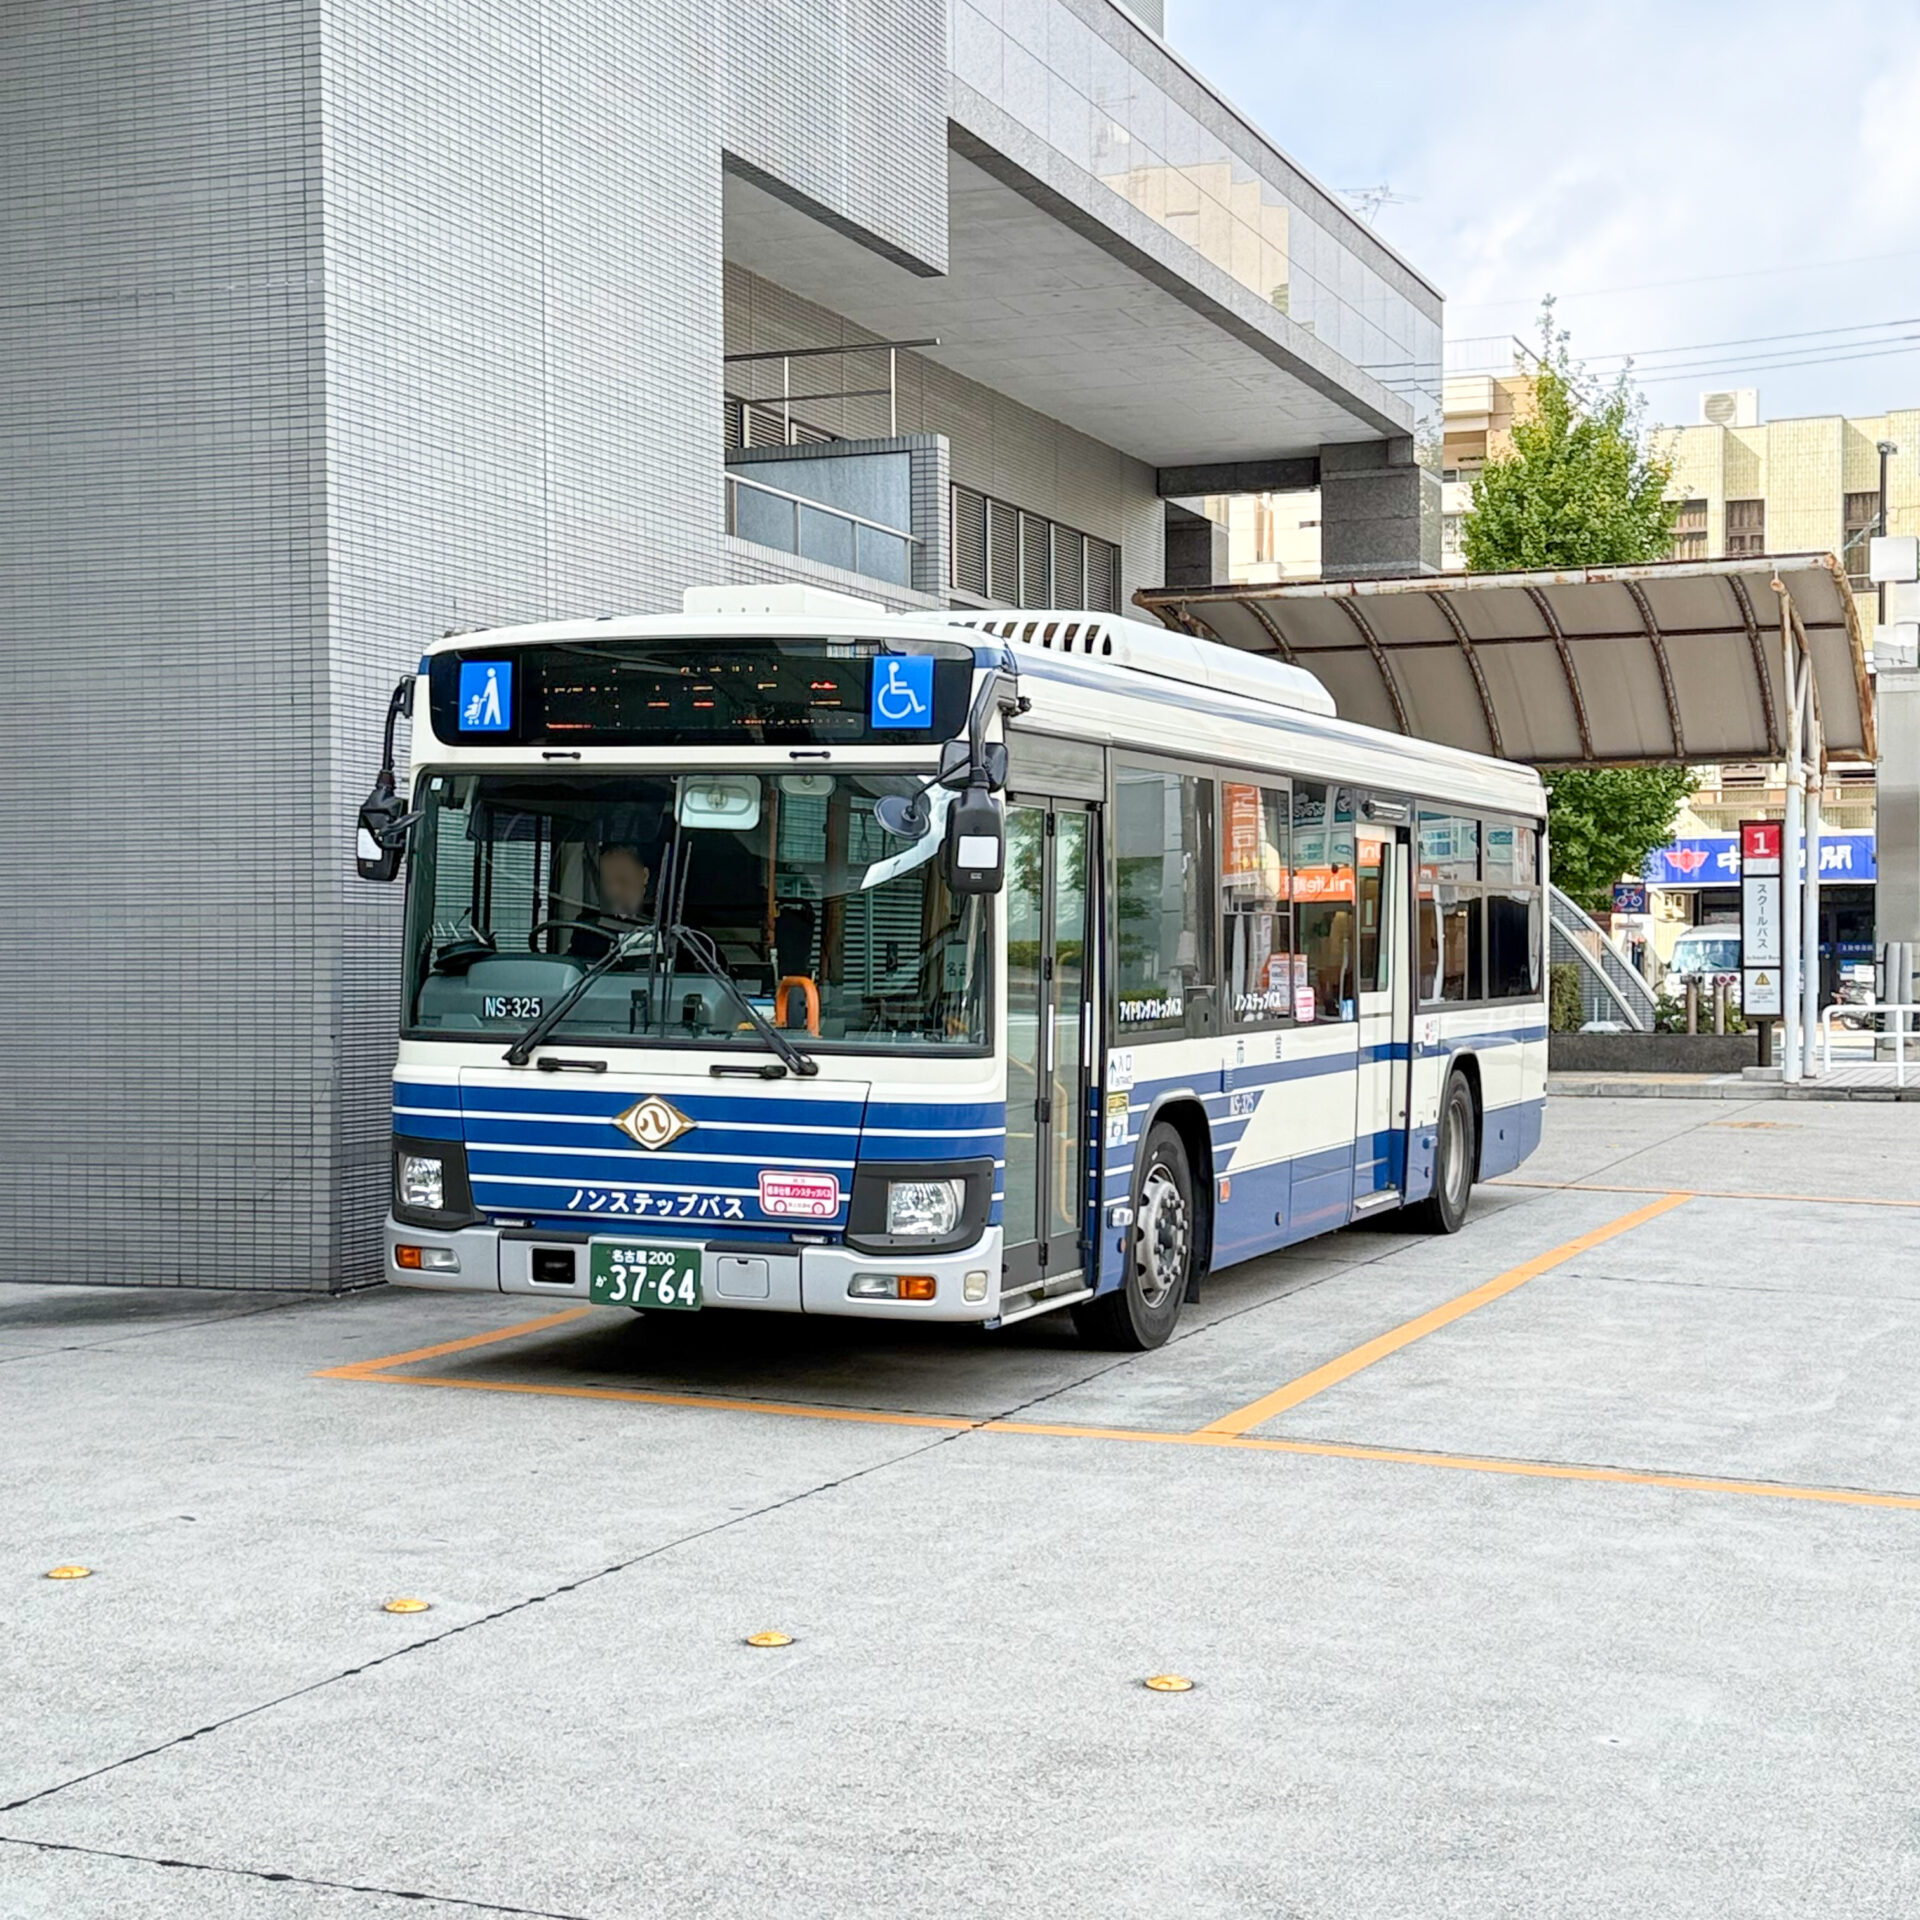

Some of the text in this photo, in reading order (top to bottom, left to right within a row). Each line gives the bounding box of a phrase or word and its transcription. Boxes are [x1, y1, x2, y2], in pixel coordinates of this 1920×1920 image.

[1753, 831, 1770, 854] 1
[1757, 884, 1768, 948] スクールバス
[485, 997, 540, 1018] NS-325
[567, 1189, 745, 1219] ノンステップバス
[609, 1264, 696, 1306] 37-64
